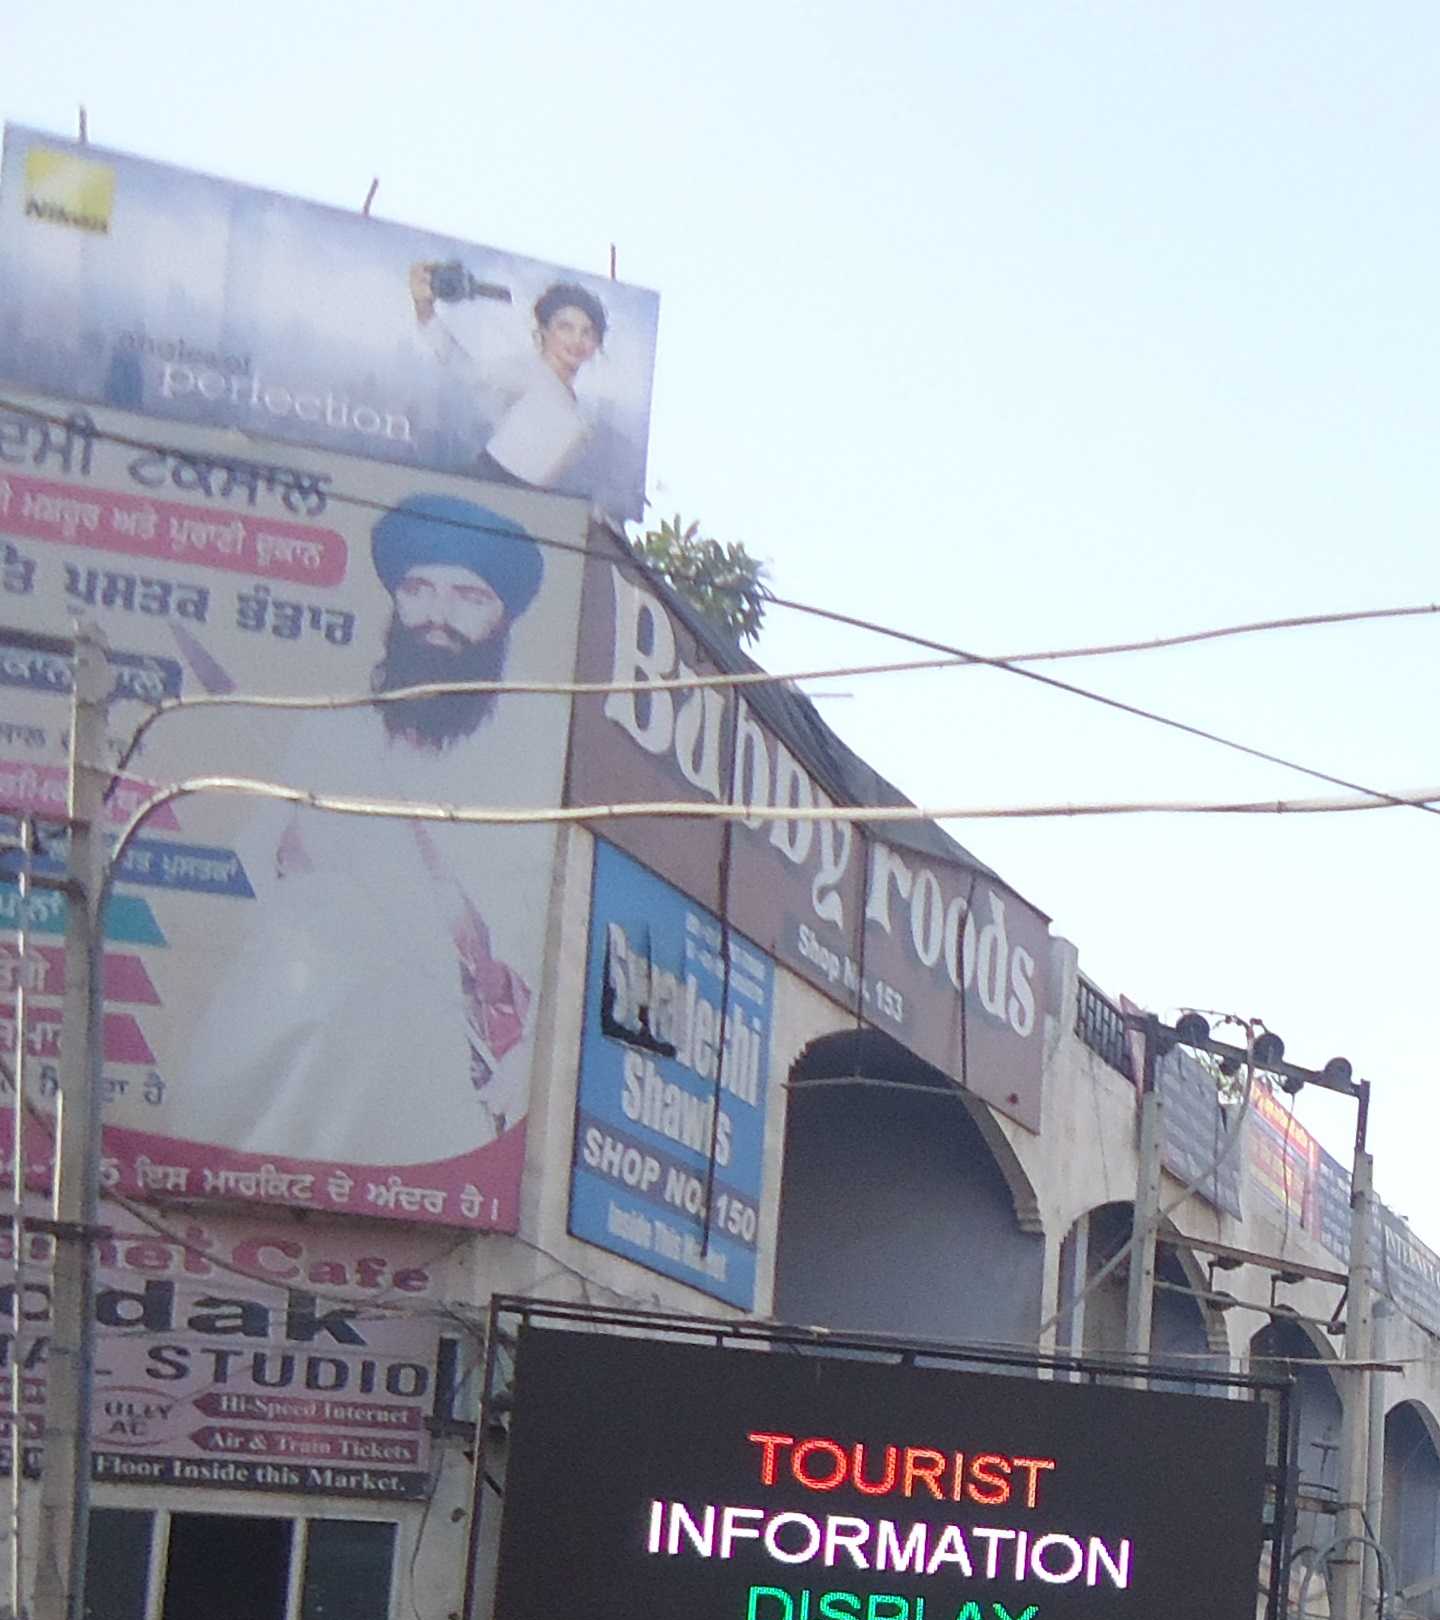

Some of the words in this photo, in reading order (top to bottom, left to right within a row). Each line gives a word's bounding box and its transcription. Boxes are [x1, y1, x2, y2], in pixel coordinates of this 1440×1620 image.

[162, 362, 413, 442] perfection
[583, 1126, 661, 1192] SHOP
[716, 1193, 758, 1243] 150
[231, 1237, 430, 1293] Cafe
[145, 1344, 431, 1398] STUDIO
[221, 1395, 318, 1420] Hi-Speed
[323, 1399, 409, 1425] Internet
[95, 1453, 165, 1476] Floor
[173, 1456, 249, 1484] Inside
[256, 1464, 300, 1486] this
[306, 1468, 406, 1493] Market.
[749, 1431, 1056, 1510] TOURIST
[646, 1500, 1132, 1590] INFORMATION
